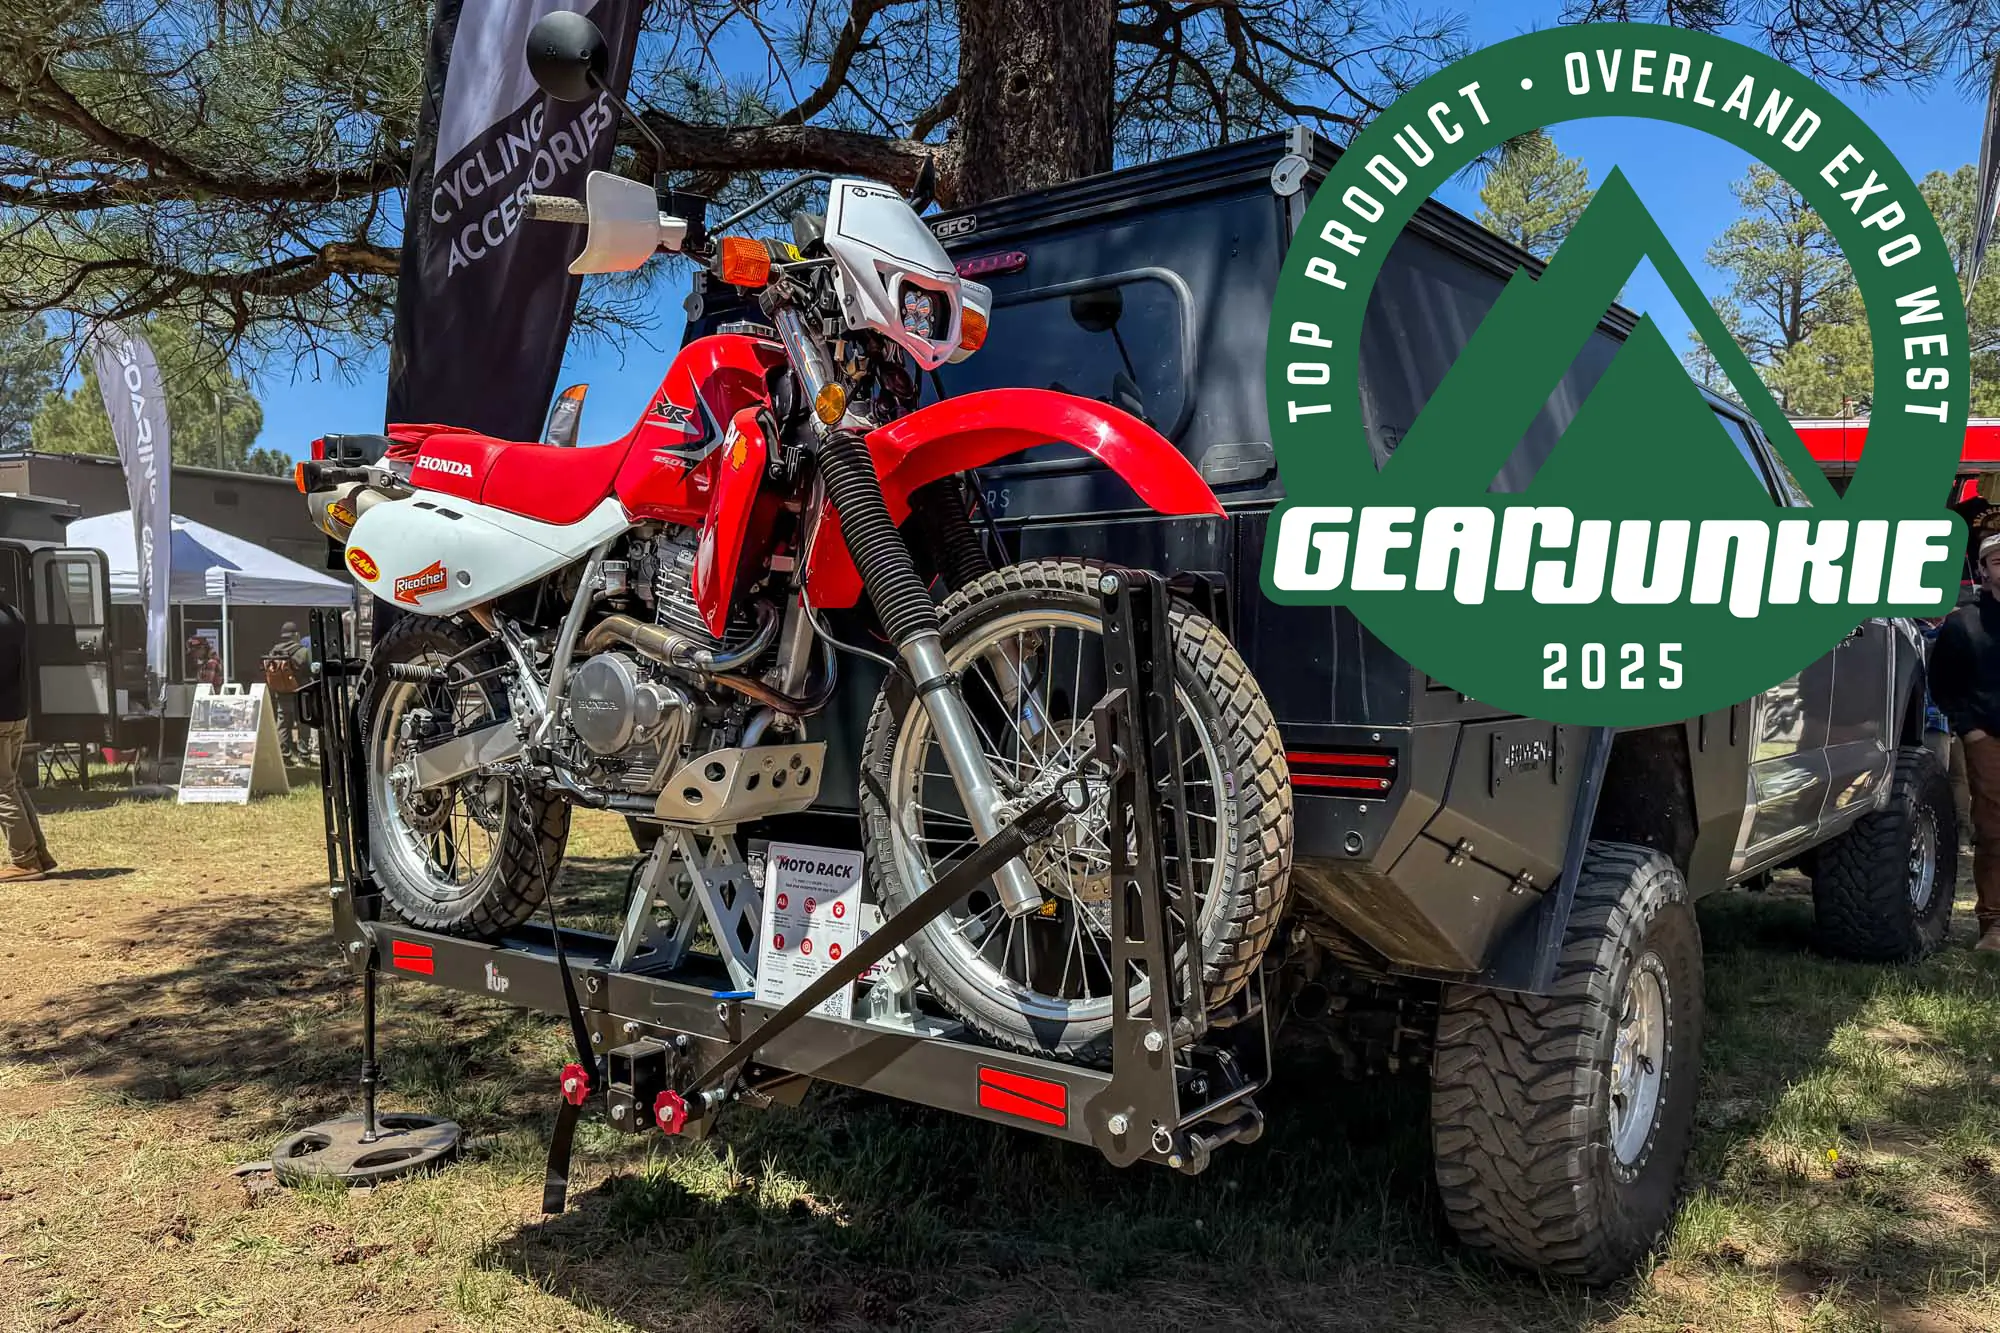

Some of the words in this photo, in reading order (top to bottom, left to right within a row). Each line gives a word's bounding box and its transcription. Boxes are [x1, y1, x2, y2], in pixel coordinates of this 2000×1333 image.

[432, 102, 544, 223] CYCLING
[936, 218, 970, 236] GFC
[416, 455, 473, 478] HONDA
[348, 551, 377, 576] FMF
[396, 571, 446, 593] Ricochet
[778, 859, 815, 874] MOTO
[816, 863, 853, 879] RACK
